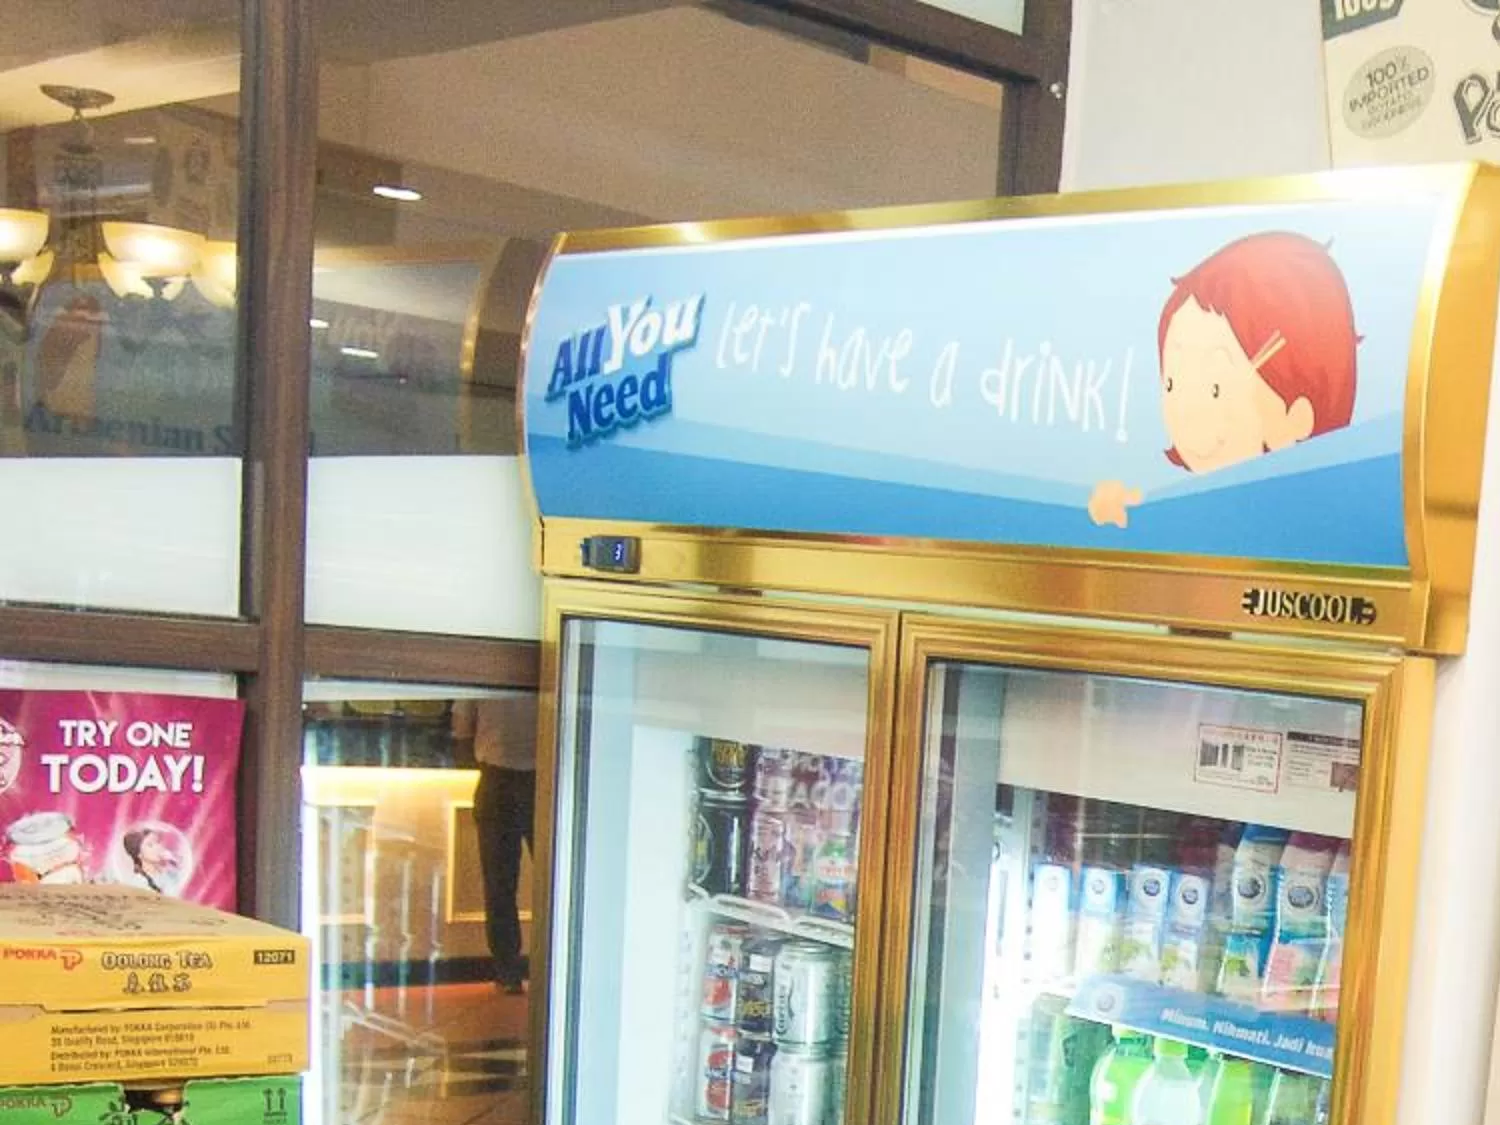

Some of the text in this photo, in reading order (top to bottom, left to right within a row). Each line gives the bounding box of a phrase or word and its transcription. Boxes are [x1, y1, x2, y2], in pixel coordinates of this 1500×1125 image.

[548, 295, 704, 394] All You
[815, 313, 913, 392] have
[930, 340, 961, 408] a
[567, 351, 673, 441] Need
[1254, 588, 1360, 622] JUSCOOL
[59, 719, 193, 749] TRY ONE
[40, 755, 206, 793] TODAY!
